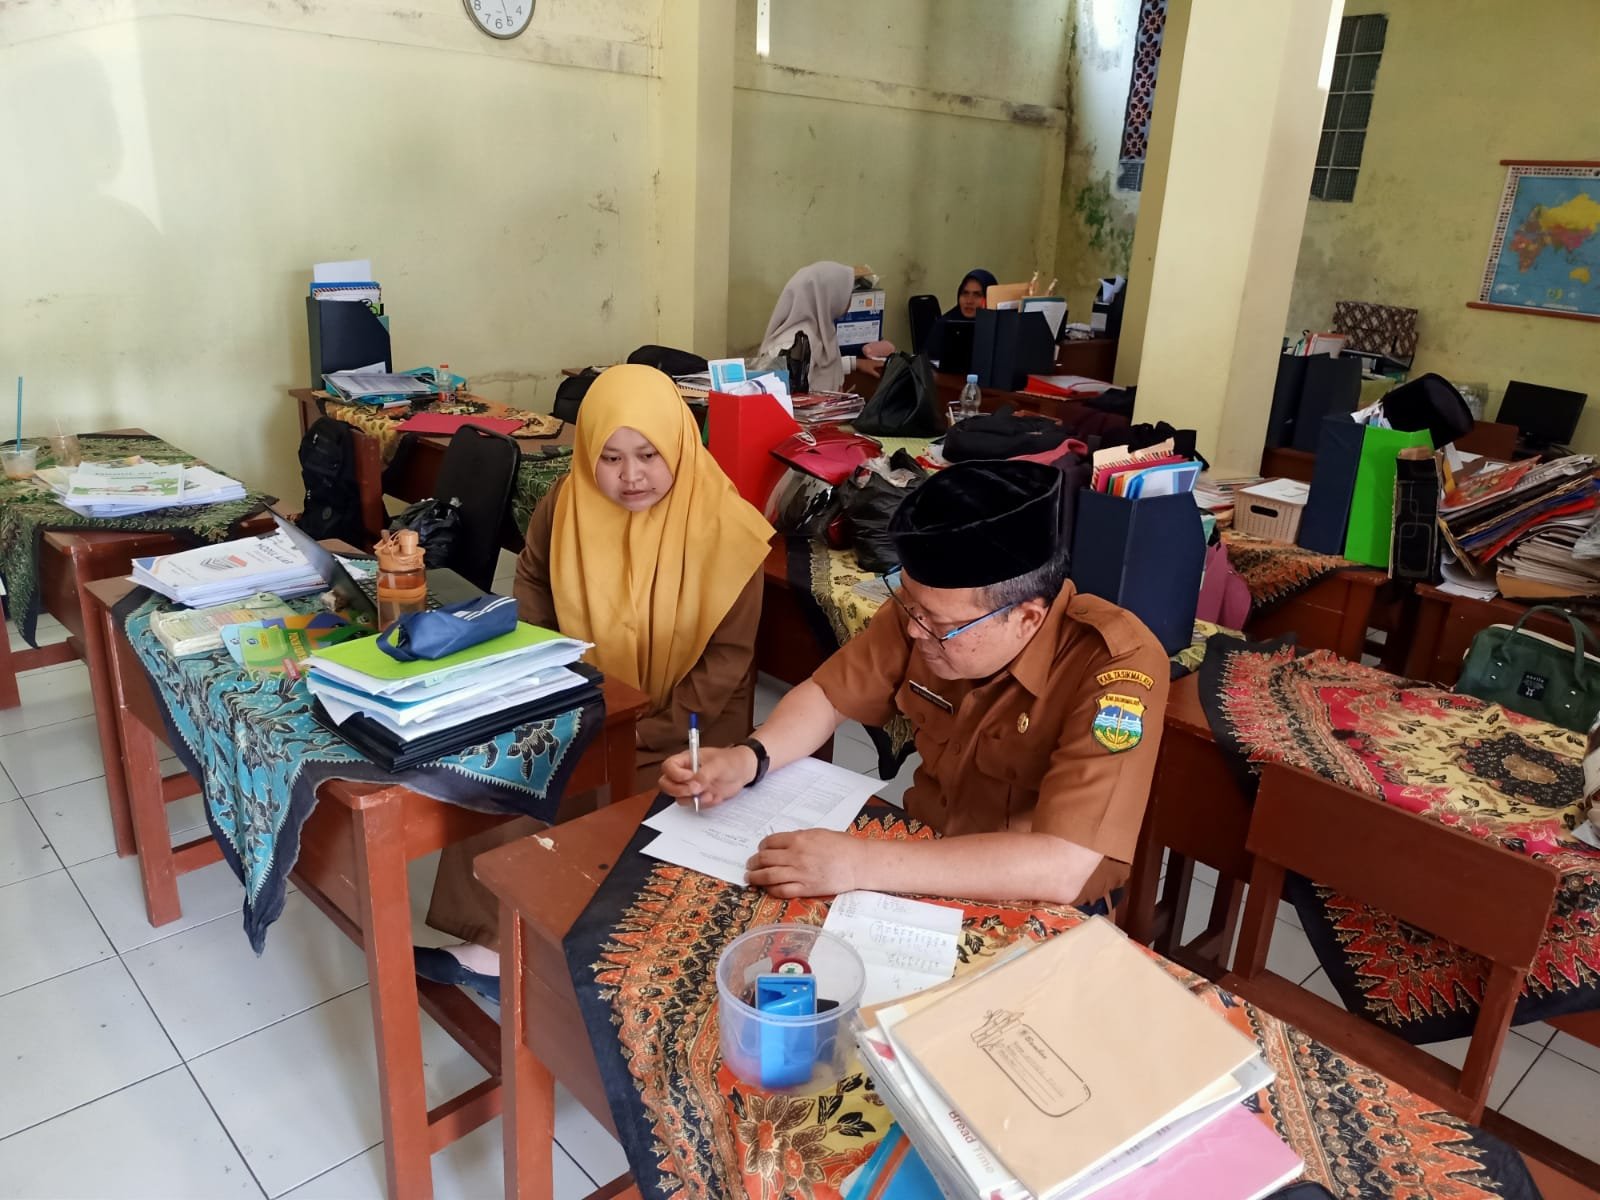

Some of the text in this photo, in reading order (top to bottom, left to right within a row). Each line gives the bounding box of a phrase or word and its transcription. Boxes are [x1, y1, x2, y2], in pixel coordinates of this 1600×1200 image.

[474, 0, 481, 11] 8
[516, 5, 522, 16] 4
[485, 13, 491, 24] 7
[495, 18, 503, 29] 6
[506, 15, 513, 26] 5
